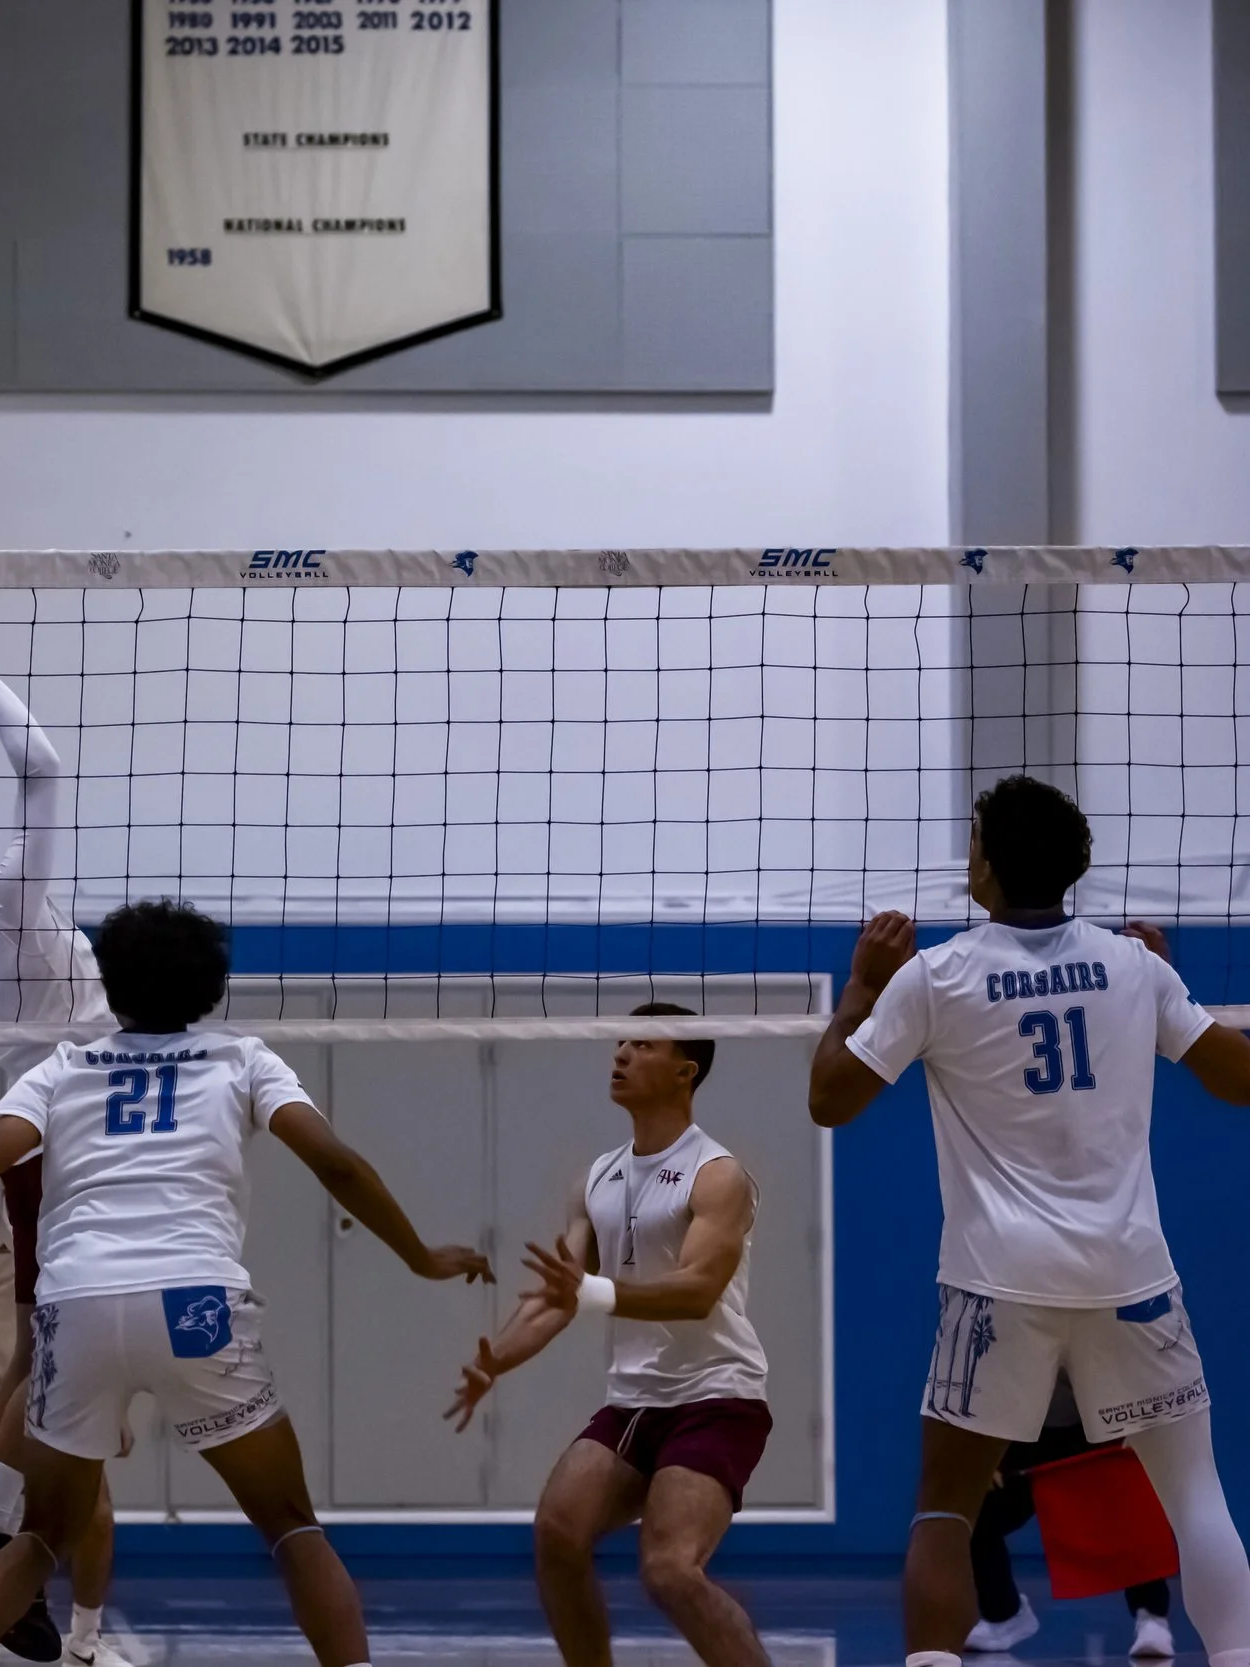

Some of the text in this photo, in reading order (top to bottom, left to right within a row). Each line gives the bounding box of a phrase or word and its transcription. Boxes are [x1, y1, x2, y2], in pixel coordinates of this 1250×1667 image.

[231, 11, 276, 29] 1991
[357, 11, 398, 29] 2011
[410, 11, 472, 30] 2012
[165, 35, 345, 56] 2013 2014 2015
[243, 133, 390, 147] STATE CHAMPIONS
[223, 218, 406, 233] NATIONAL CHAMPIONS
[248, 550, 326, 569] SMC
[758, 548, 837, 567] SMC
[240, 571, 329, 579] VOLLEYBALL
[987, 962, 1108, 1002] CORSAIRS
[1018, 1006, 1096, 1094] 31
[105, 1064, 178, 1136] 21
[177, 1389, 275, 1437] VOLLEYBALL
[1098, 1402, 1133, 1415] SANTA
[1137, 1391, 1176, 1407] MONICA
[1101, 1383, 1206, 1425] VOLLEYBALL
